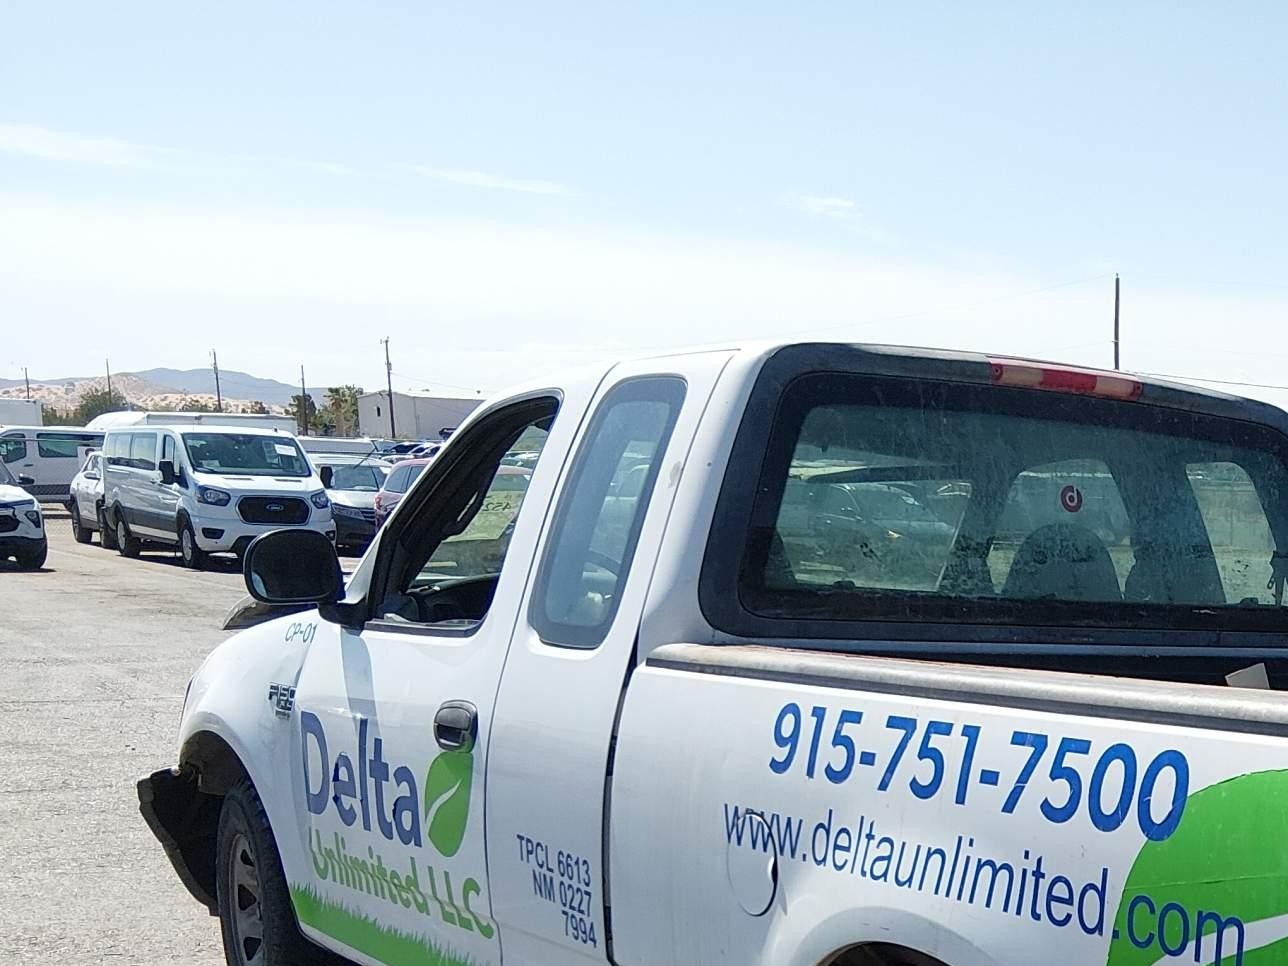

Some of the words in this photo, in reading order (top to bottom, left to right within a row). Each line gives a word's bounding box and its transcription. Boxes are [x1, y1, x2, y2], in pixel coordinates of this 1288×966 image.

[285, 622, 318, 643] CP-01
[301, 711, 422, 848] Delta
[769, 703, 1189, 842] 915-751-7500
[309, 827, 430, 916] Unlimited
[428, 865, 494, 939] LLC
[517, 834, 554, 873] TPCL
[558, 849, 591, 887] 6613
[533, 869, 555, 903] NM
[559, 880, 592, 917] 0227
[562, 910, 597, 948] 7994
